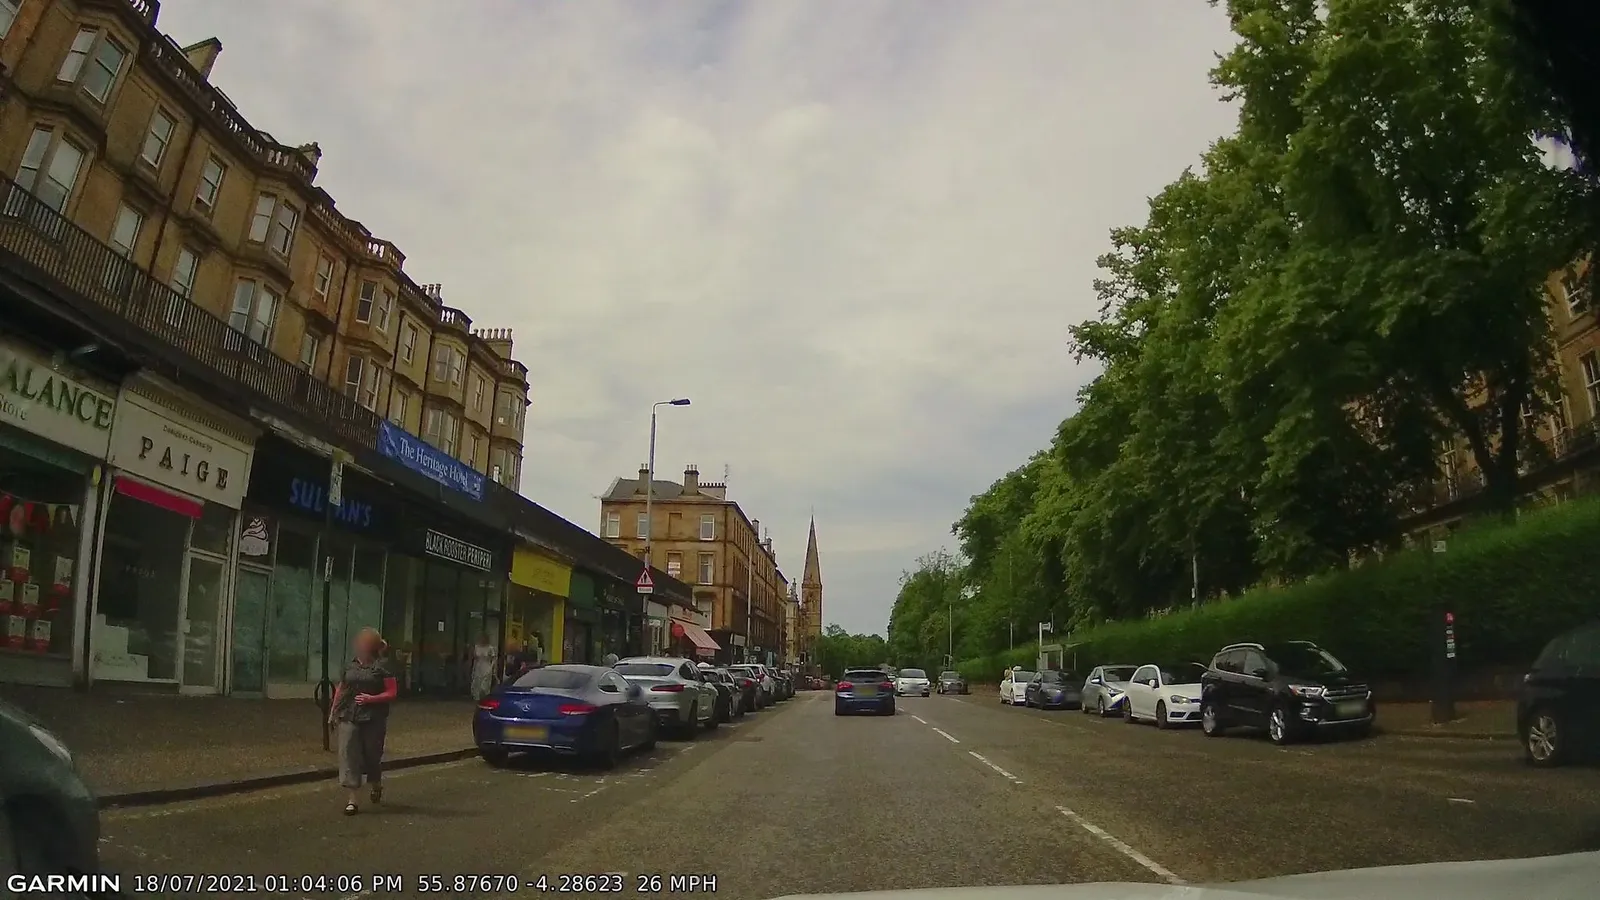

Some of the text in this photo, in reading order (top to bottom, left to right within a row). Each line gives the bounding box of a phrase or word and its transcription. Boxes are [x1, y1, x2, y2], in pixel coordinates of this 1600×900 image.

[139, 435, 228, 490] PAIGE
[400, 437, 415, 459] The
[415, 447, 448, 478] Heritage
[449, 464, 468, 487] Hotel
[290, 477, 372, 527] SULAN'S
[426, 531, 444, 554] BLACK
[444, 538, 467, 561] ROOSTER
